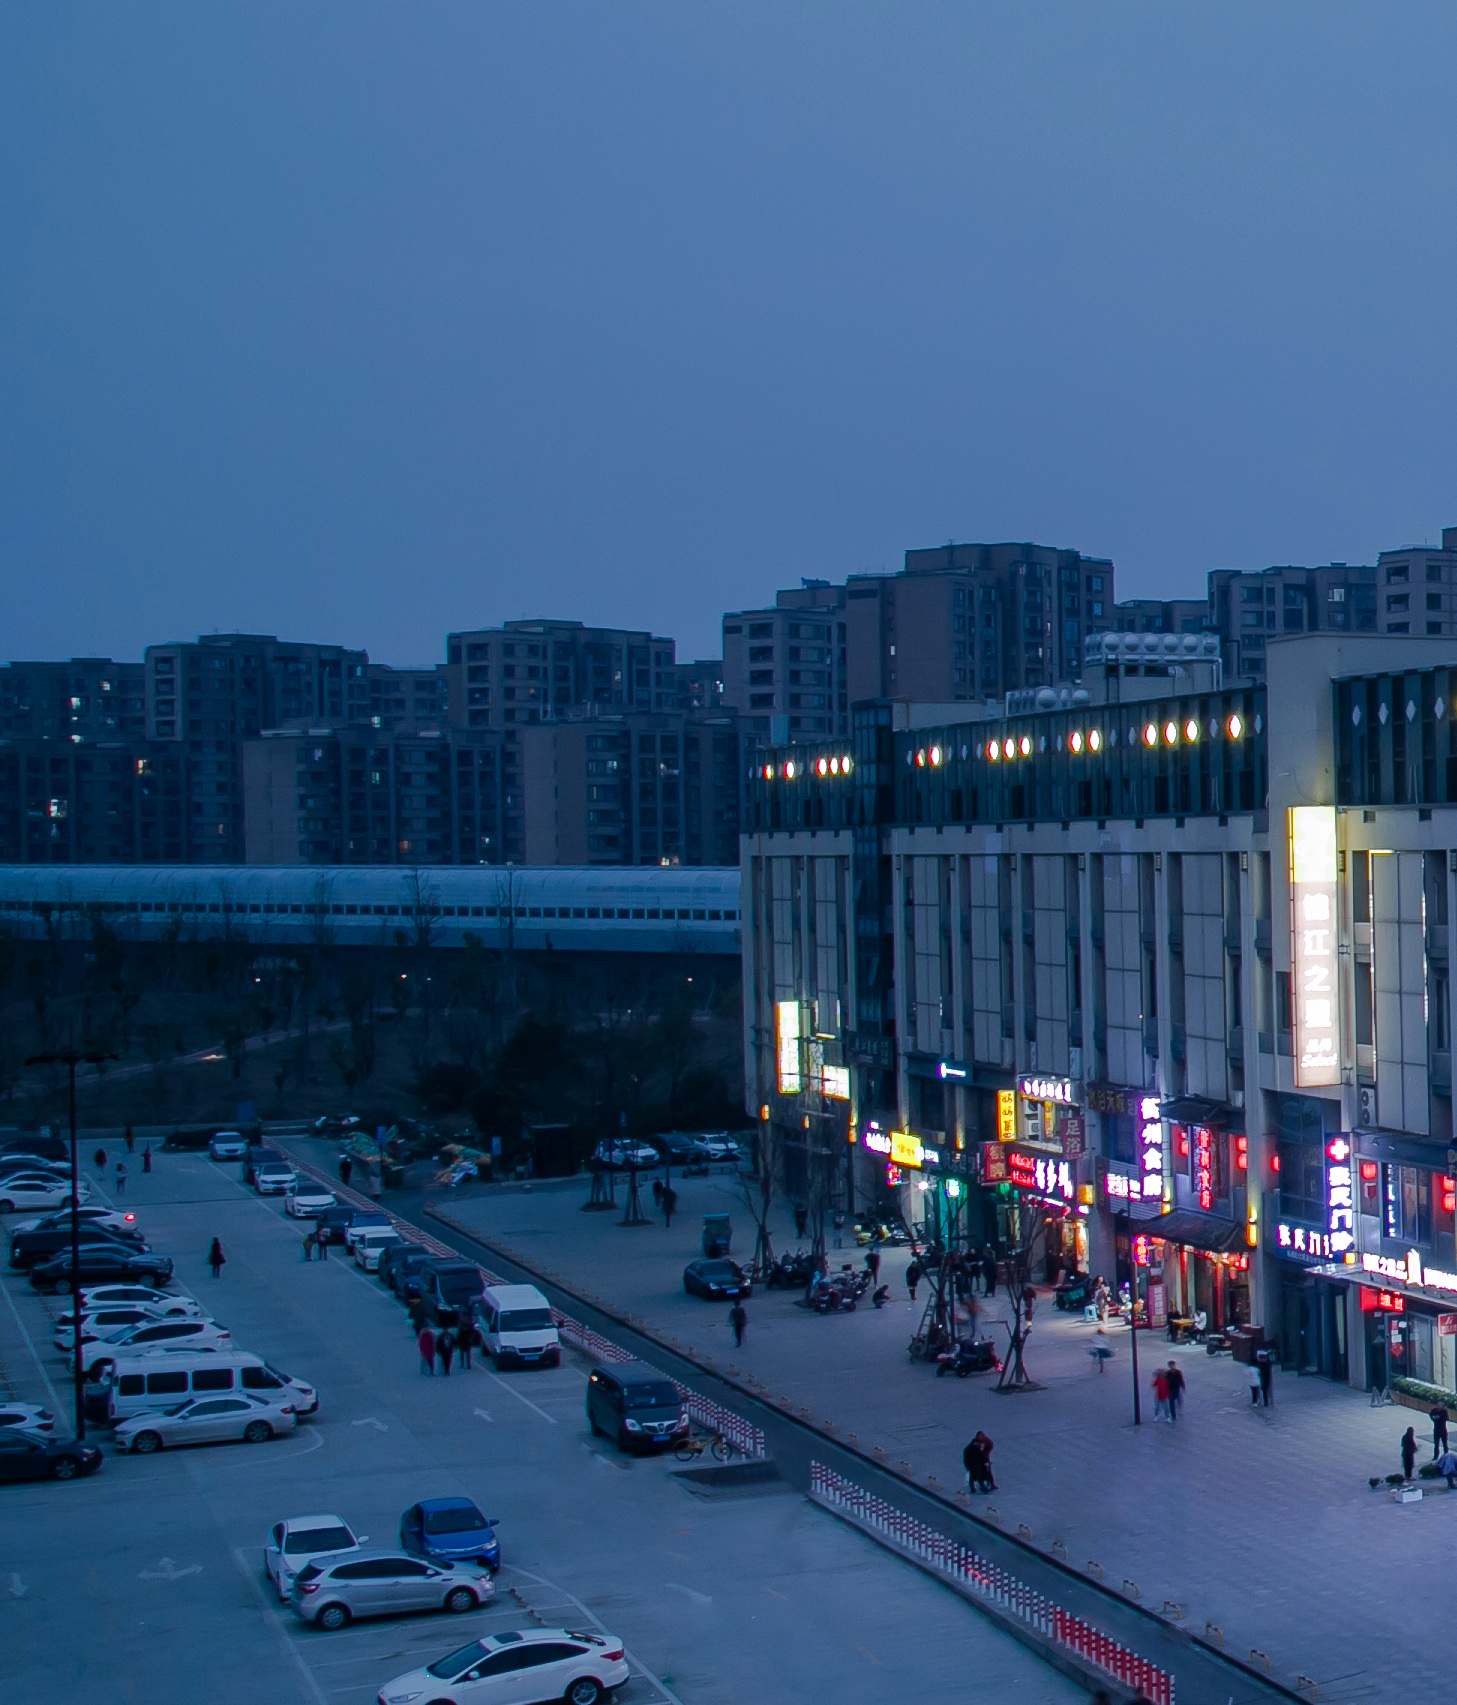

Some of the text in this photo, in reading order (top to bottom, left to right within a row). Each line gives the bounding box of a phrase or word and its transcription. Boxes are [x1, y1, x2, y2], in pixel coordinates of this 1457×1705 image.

[1302, 893, 1332, 1028] 锦江之星
[1066, 1119, 1082, 1154] 足浴
